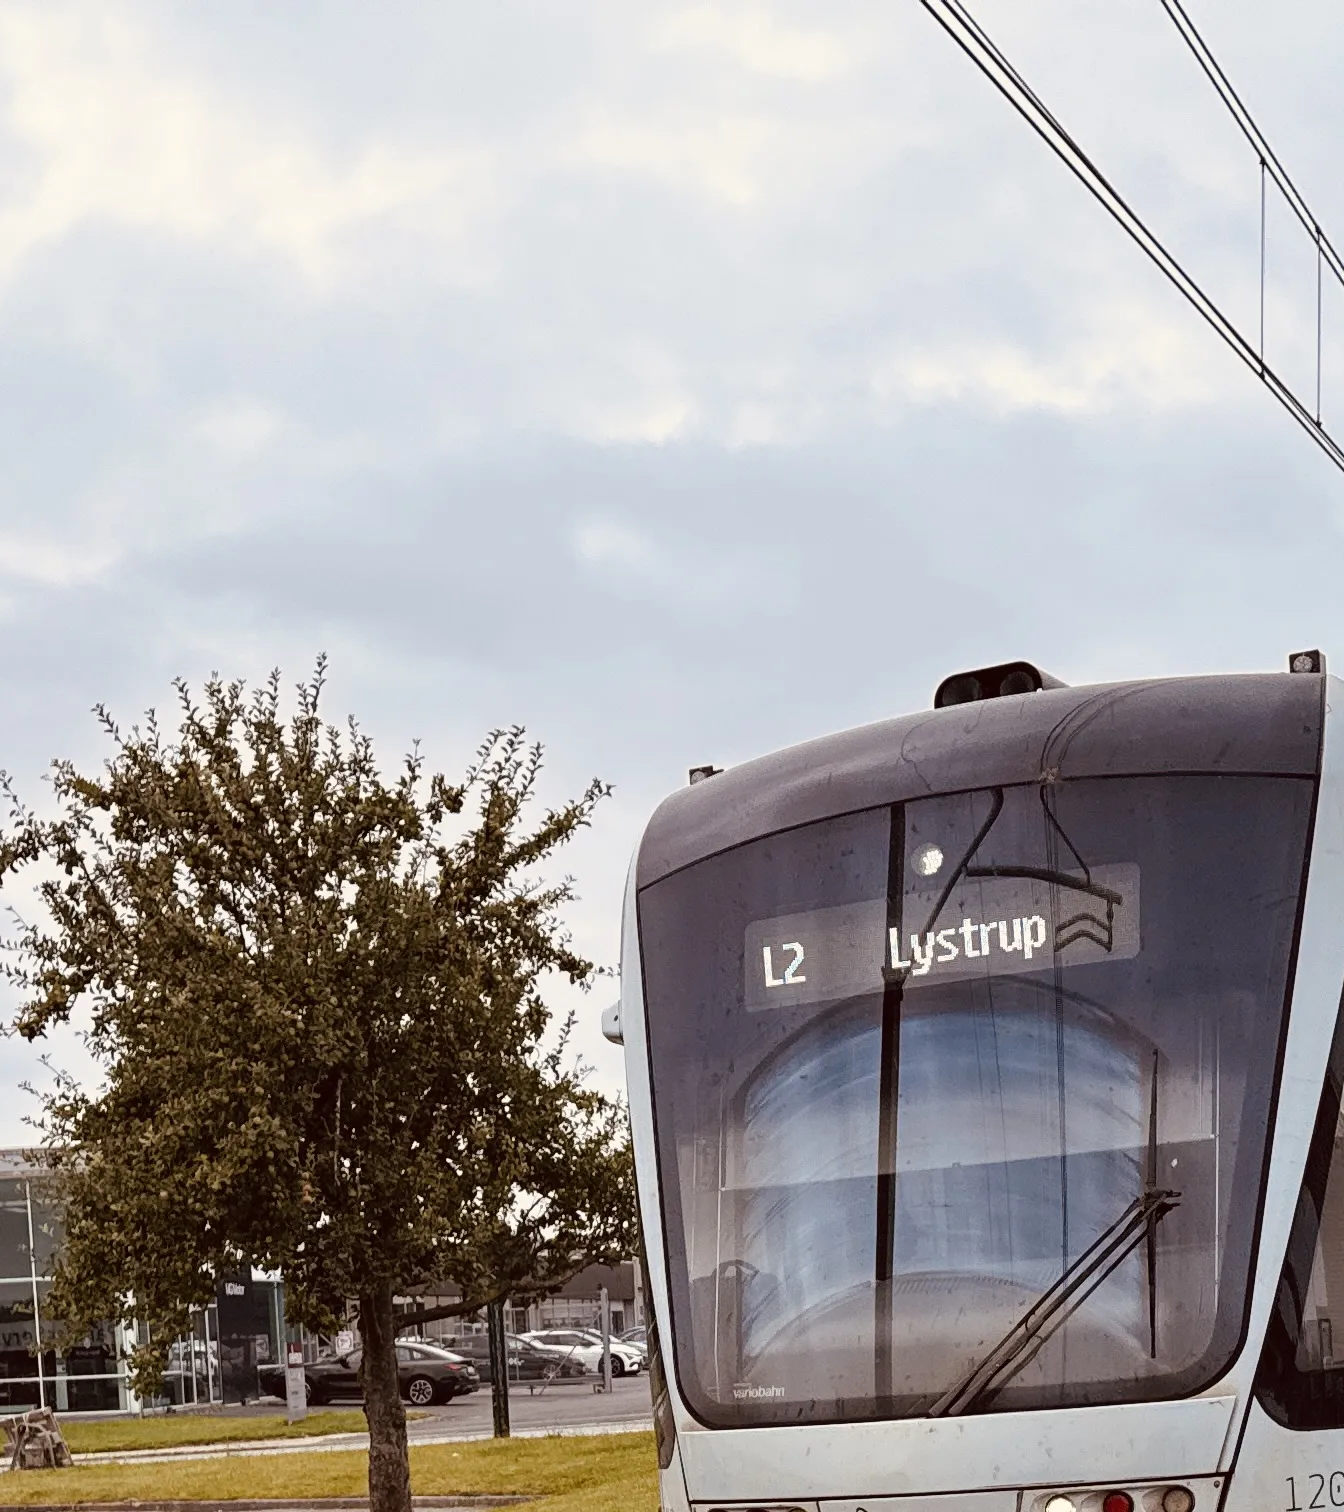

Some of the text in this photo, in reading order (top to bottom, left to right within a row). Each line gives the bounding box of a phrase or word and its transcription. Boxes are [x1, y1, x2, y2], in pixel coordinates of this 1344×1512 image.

[762, 914, 1047, 988] L2 Lystrup
[732, 1384, 786, 1399] variobahn
